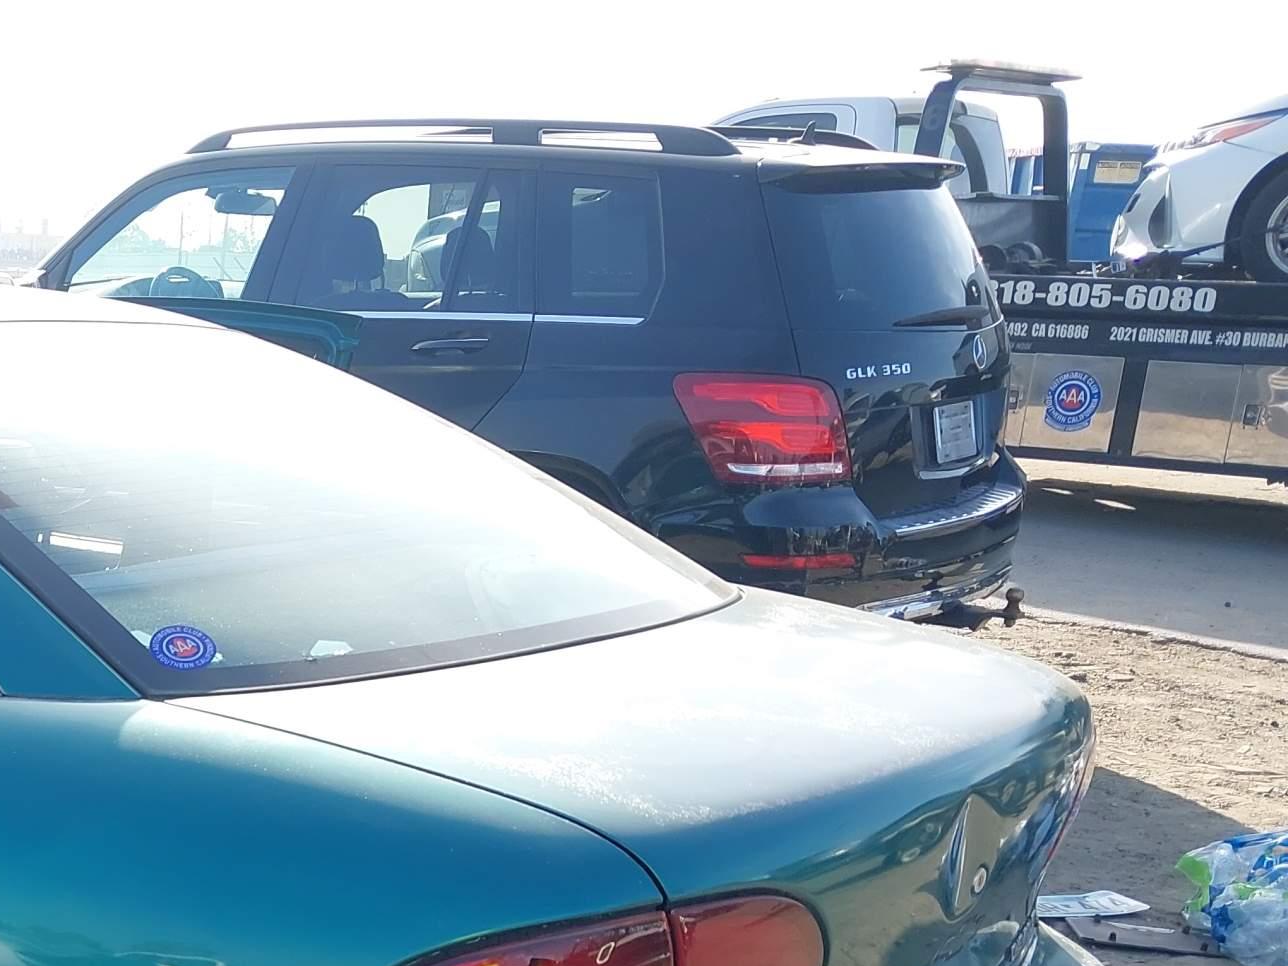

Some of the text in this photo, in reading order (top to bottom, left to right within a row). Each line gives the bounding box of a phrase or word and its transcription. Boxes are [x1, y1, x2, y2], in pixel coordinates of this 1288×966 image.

[1005, 321, 1029, 337] 492
[1032, 323, 1046, 338] CA
[1109, 326, 1137, 342] 2021
[1138, 327, 1189, 344] GRISMER
[1189, 329, 1213, 345] AVE.
[1215, 331, 1241, 347] #30
[846, 363, 911, 379] GLK 350
[1086, 377, 1099, 393] CLUB
[1059, 388, 1085, 404] AAA
[168, 639, 197, 654] AAA
